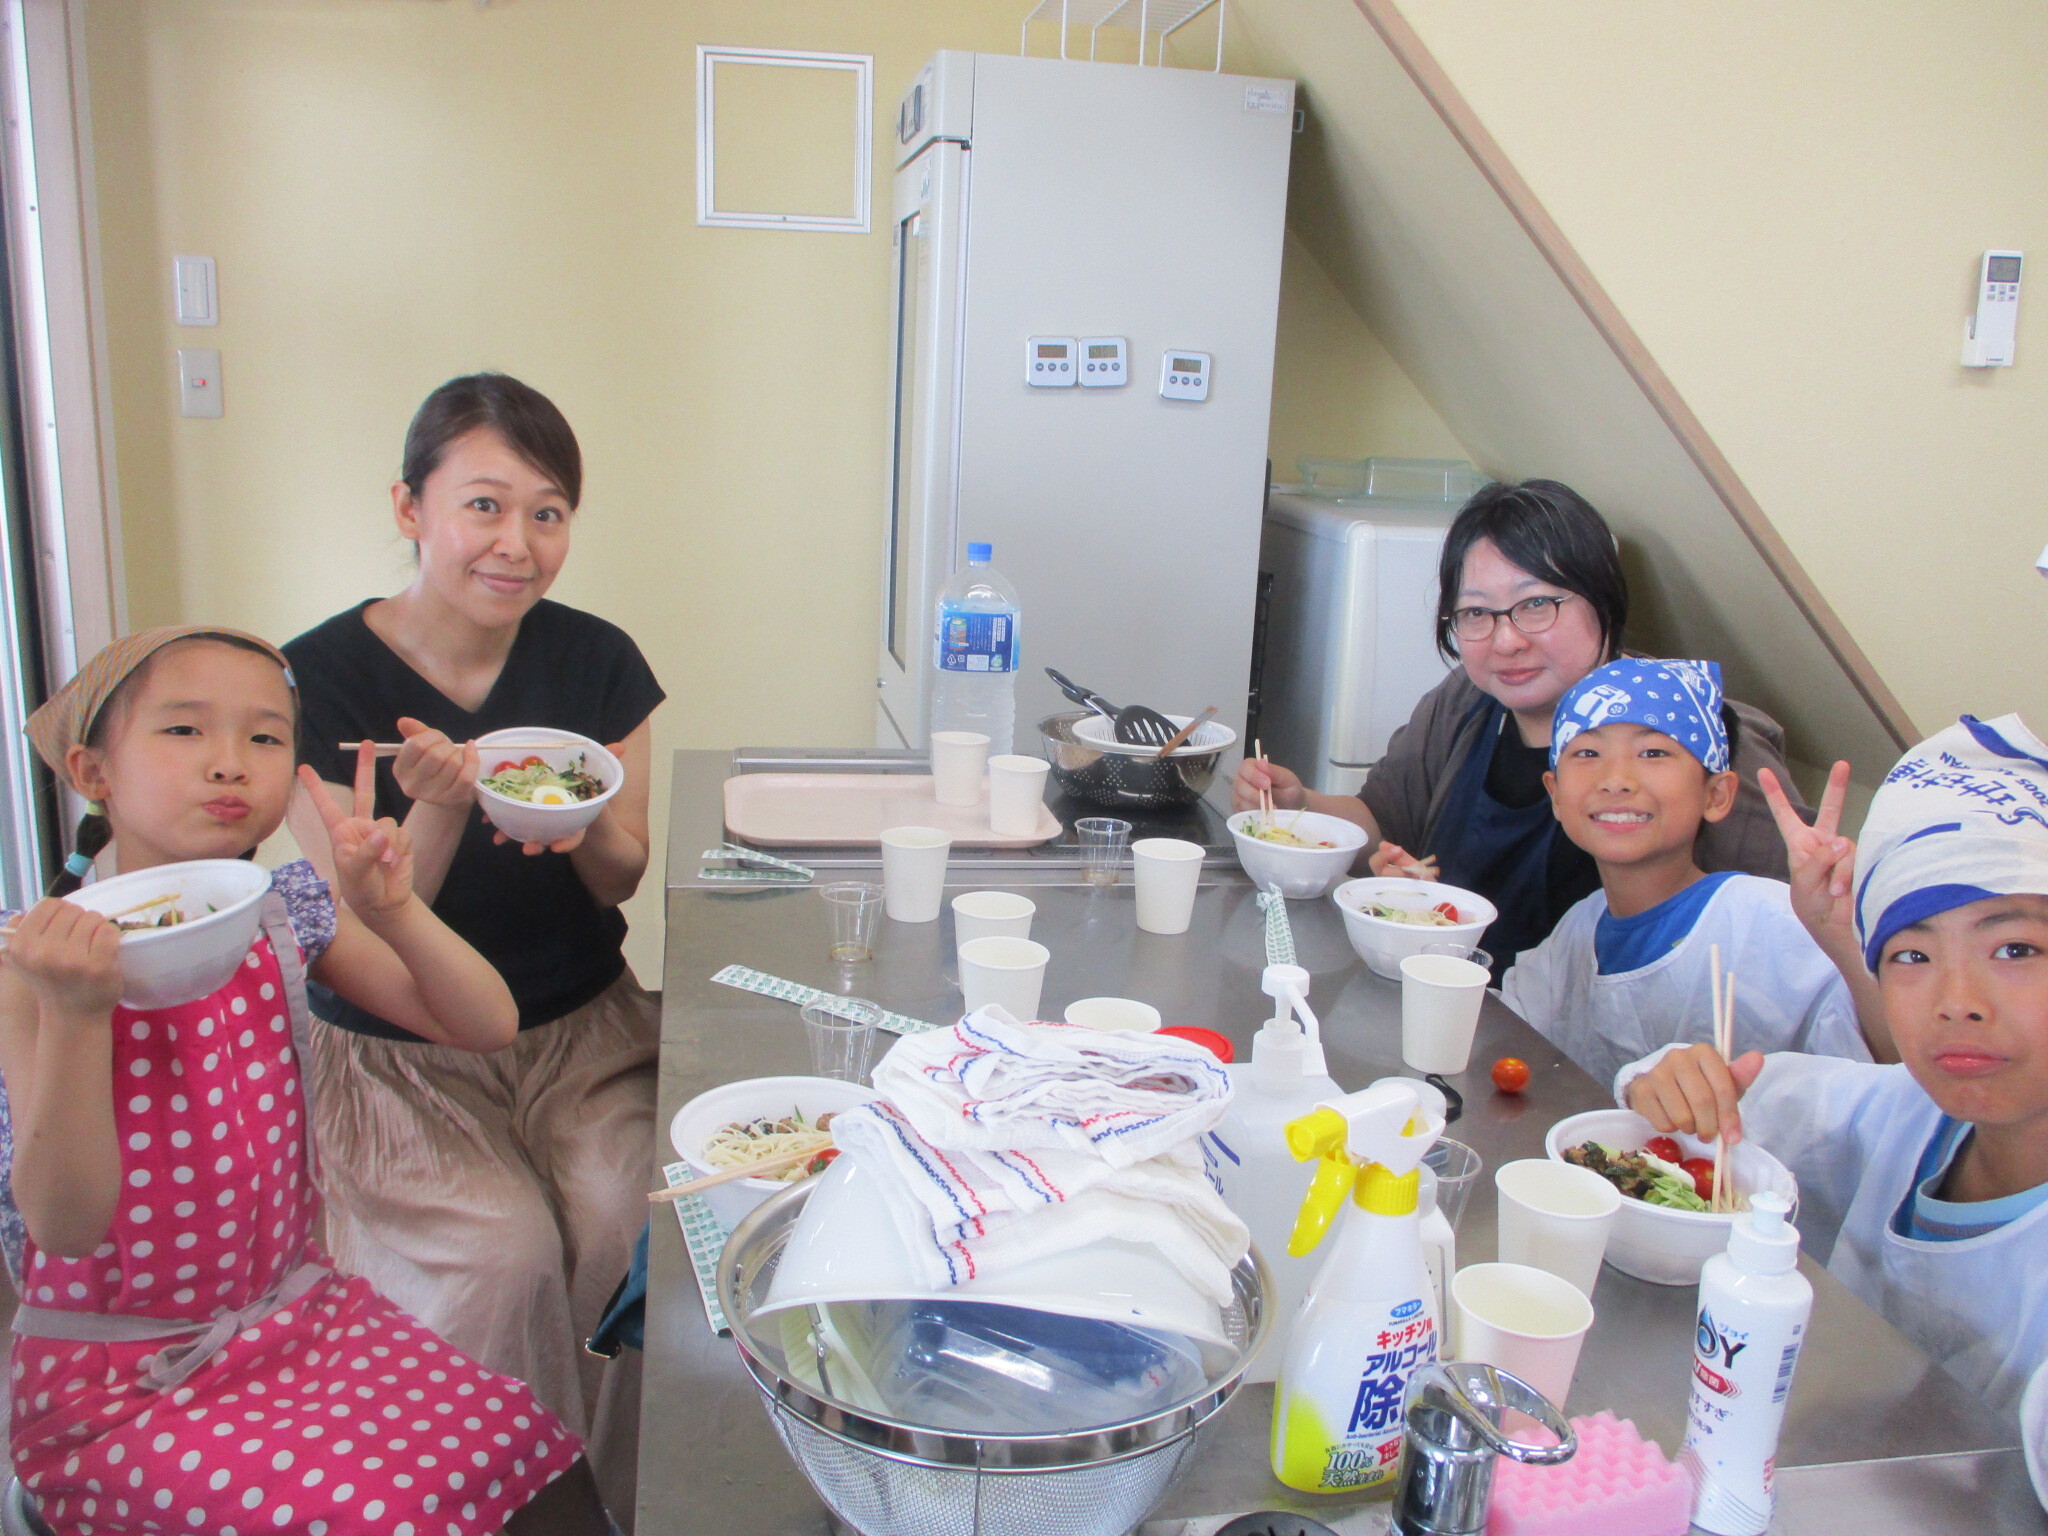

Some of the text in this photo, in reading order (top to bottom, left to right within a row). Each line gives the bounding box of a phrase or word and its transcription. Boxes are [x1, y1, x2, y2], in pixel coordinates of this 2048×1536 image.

[1376, 1317, 1432, 1350] キッチン用
[1362, 1330, 1438, 1377] アルコール
[1328, 1450, 1374, 1470] 100%
